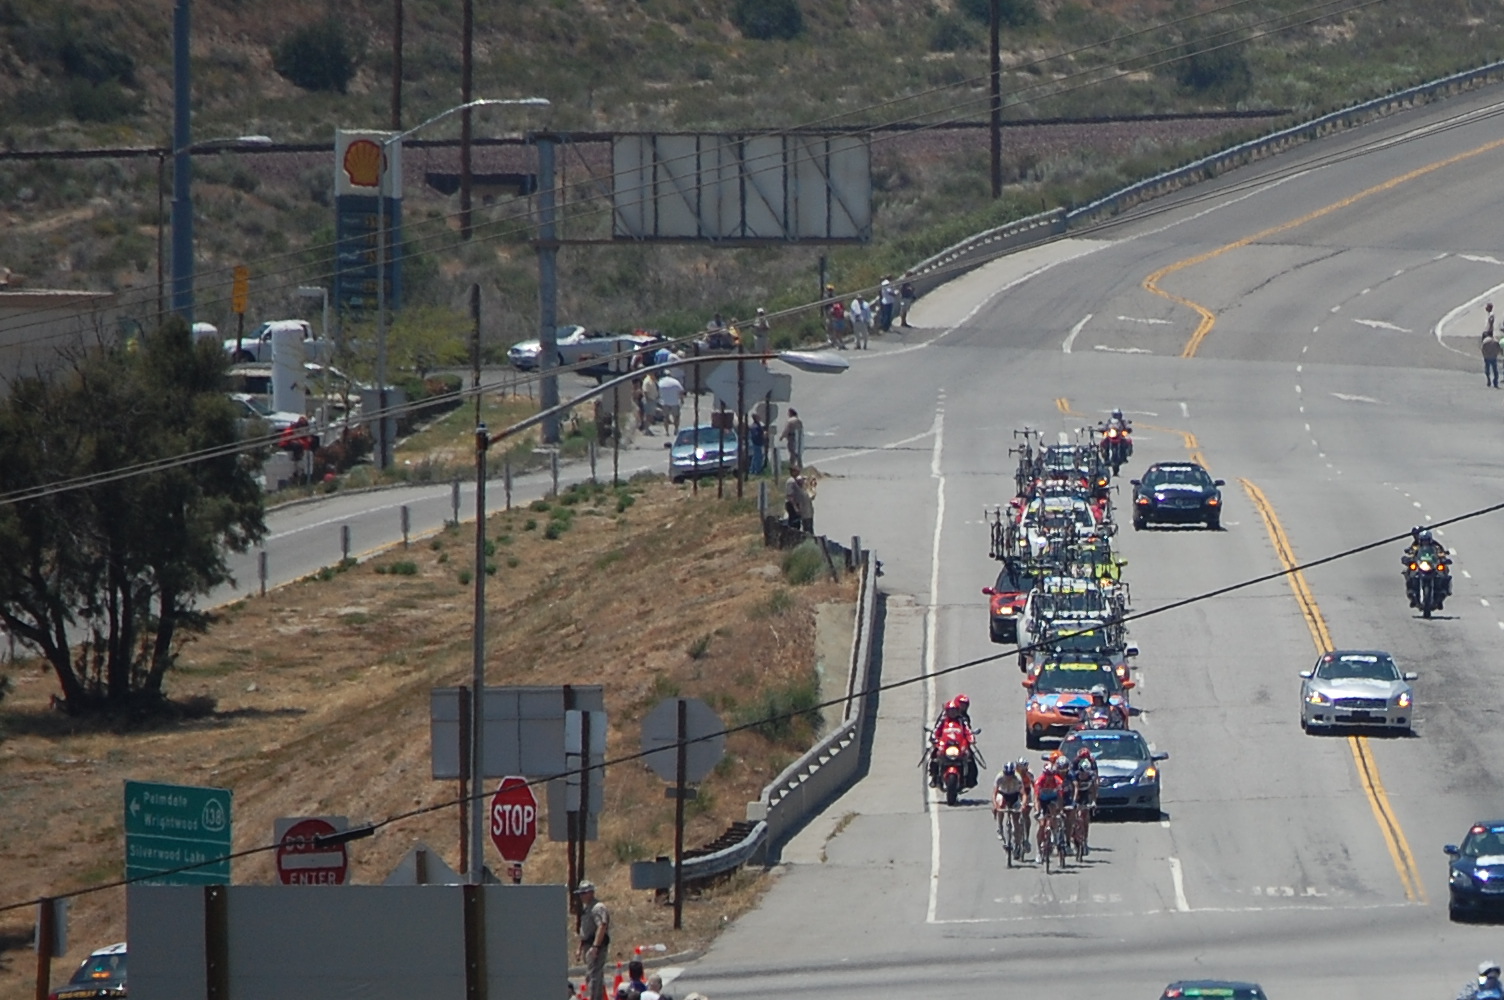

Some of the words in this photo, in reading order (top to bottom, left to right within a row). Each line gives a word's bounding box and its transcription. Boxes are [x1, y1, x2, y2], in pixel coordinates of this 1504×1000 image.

[143, 791, 188, 807] Palmdale
[143, 813, 199, 831] Wrightwood
[204, 806, 223, 826] 138
[493, 803, 534, 837] STOP
[129, 844, 181, 860] Silverwood
[183, 849, 206, 863] Lake
[290, 871, 337, 885] ENTER
